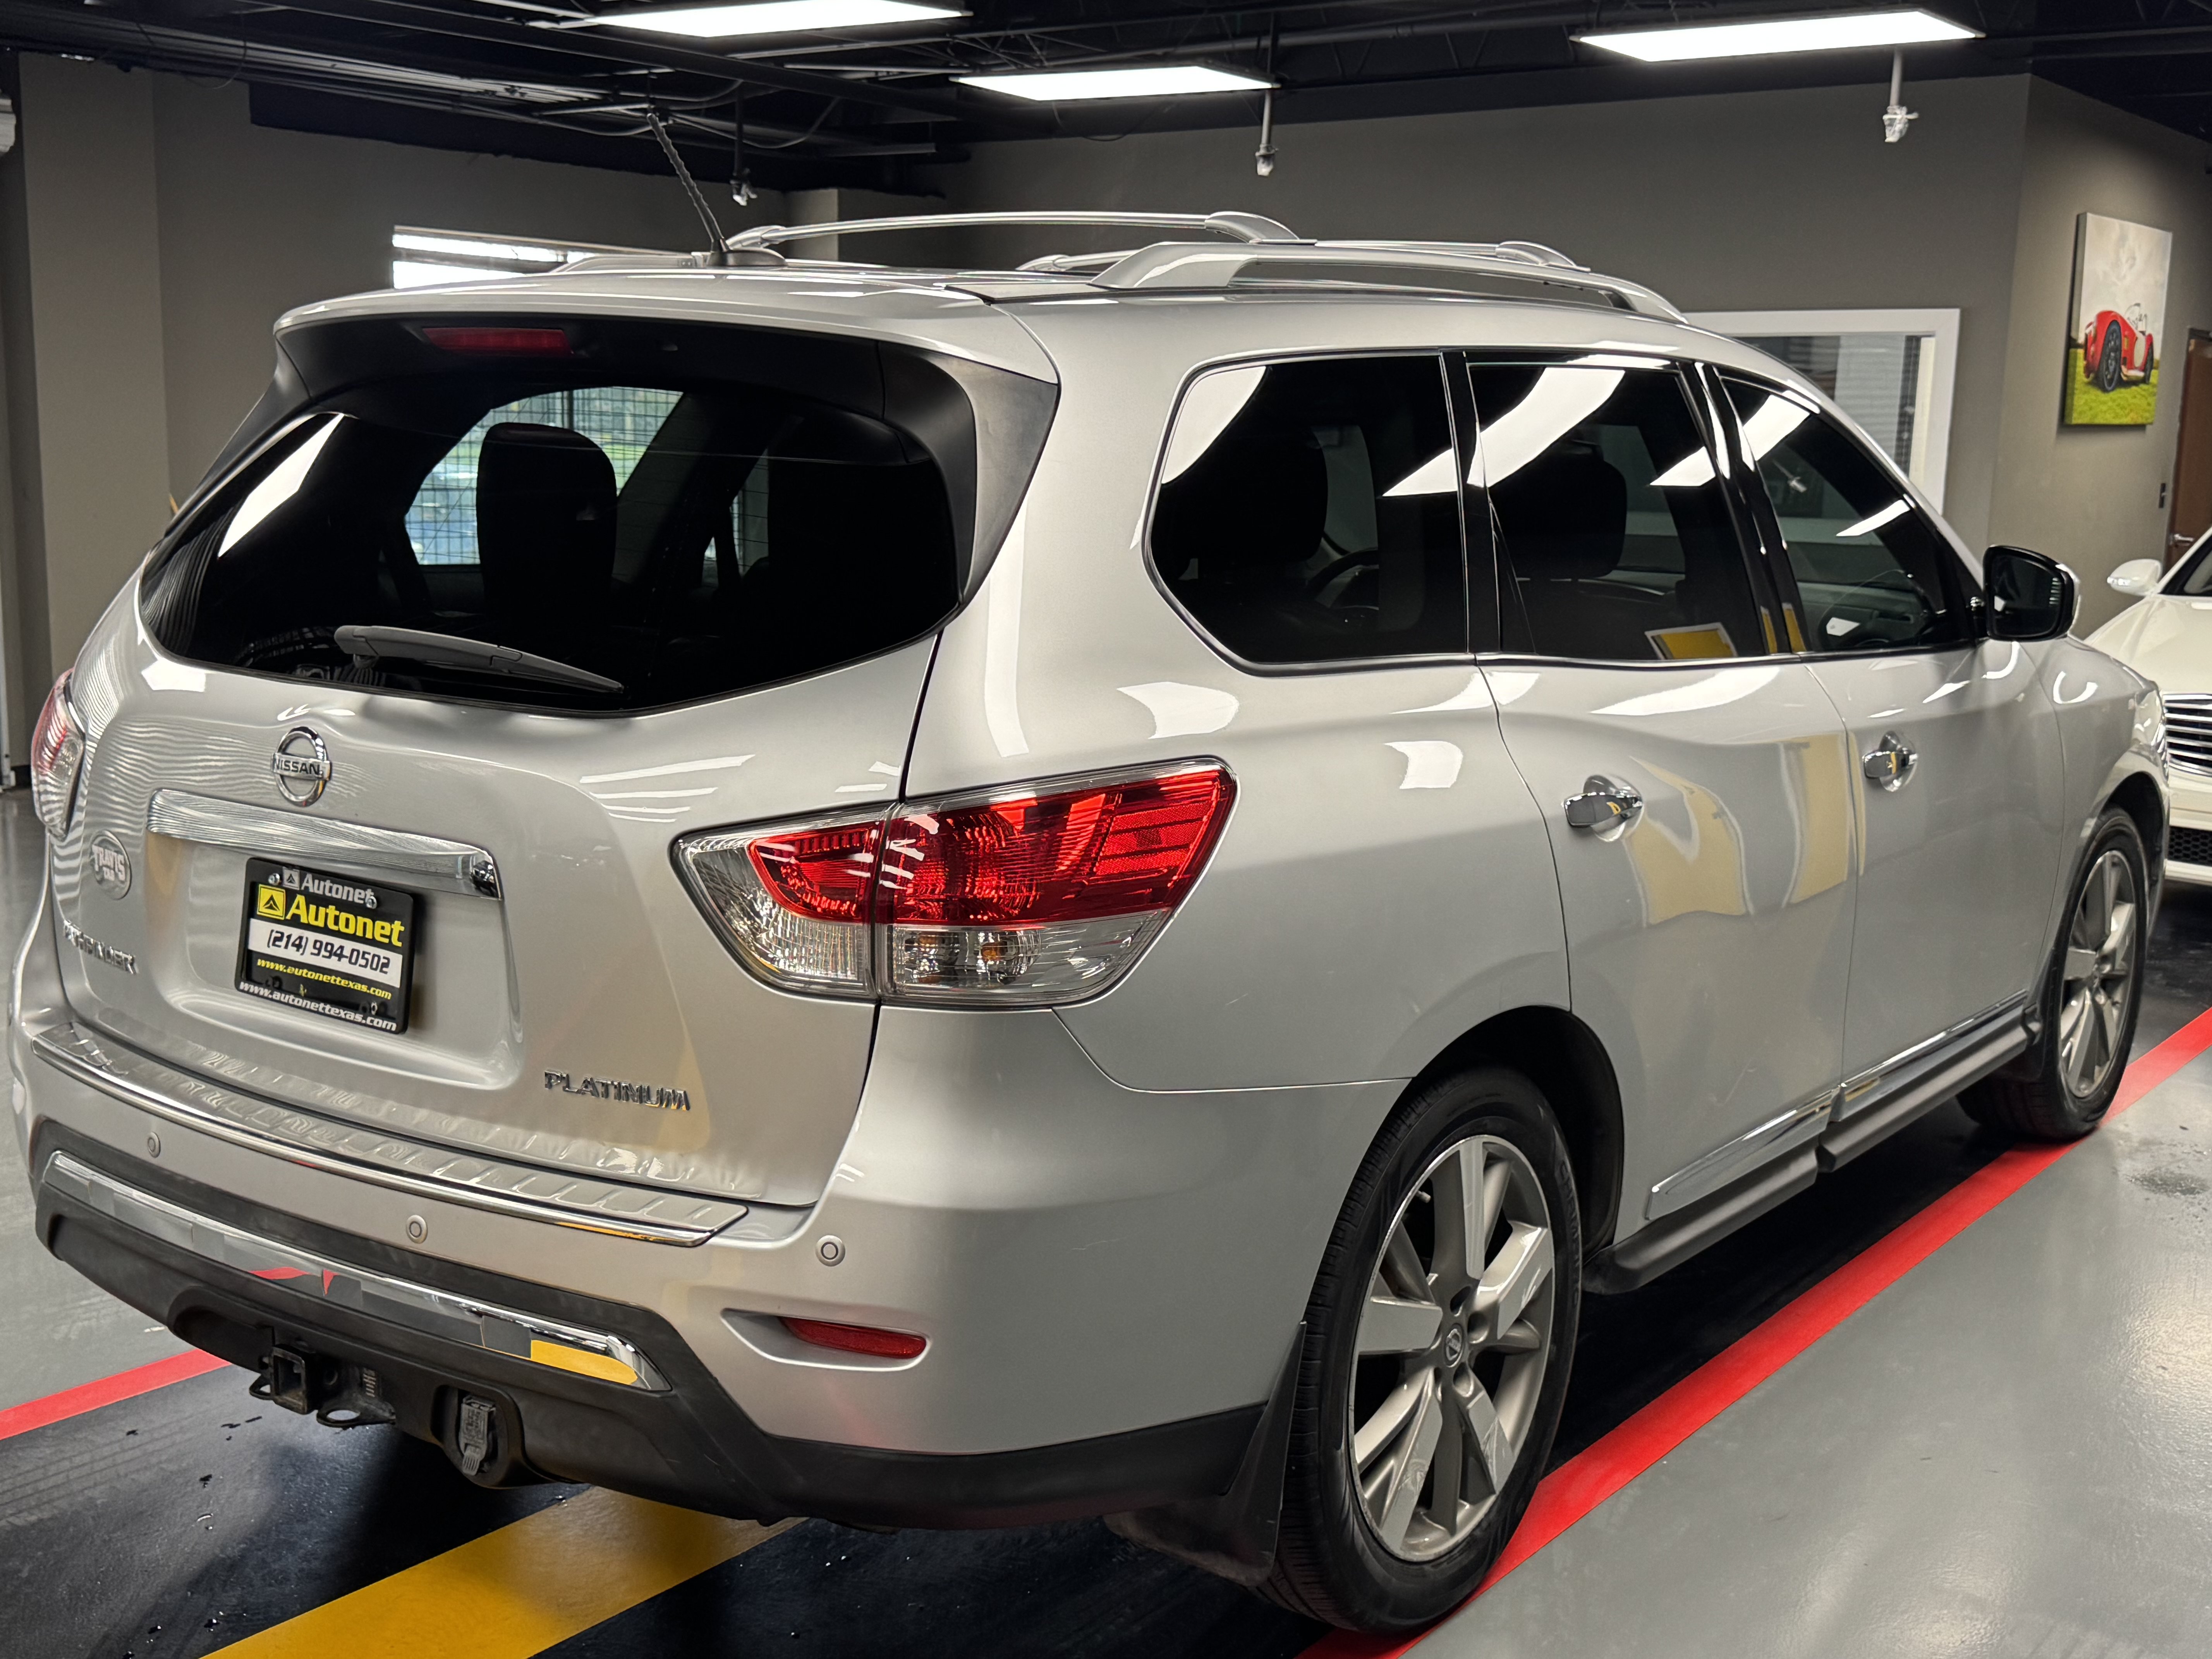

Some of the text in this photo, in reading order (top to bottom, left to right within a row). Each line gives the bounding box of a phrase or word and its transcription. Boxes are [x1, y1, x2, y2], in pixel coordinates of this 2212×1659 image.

[273, 758, 320, 775] NISSAN
[301, 873, 374, 905] Autonet
[286, 894, 405, 947] Autonet
[267, 929, 391, 975] (214) 994-0502
[257, 959, 392, 1000] www.autonettexas.com
[239, 981, 397, 1032] www.autonettexas.com
[544, 1069, 690, 1111] PLATINUM
